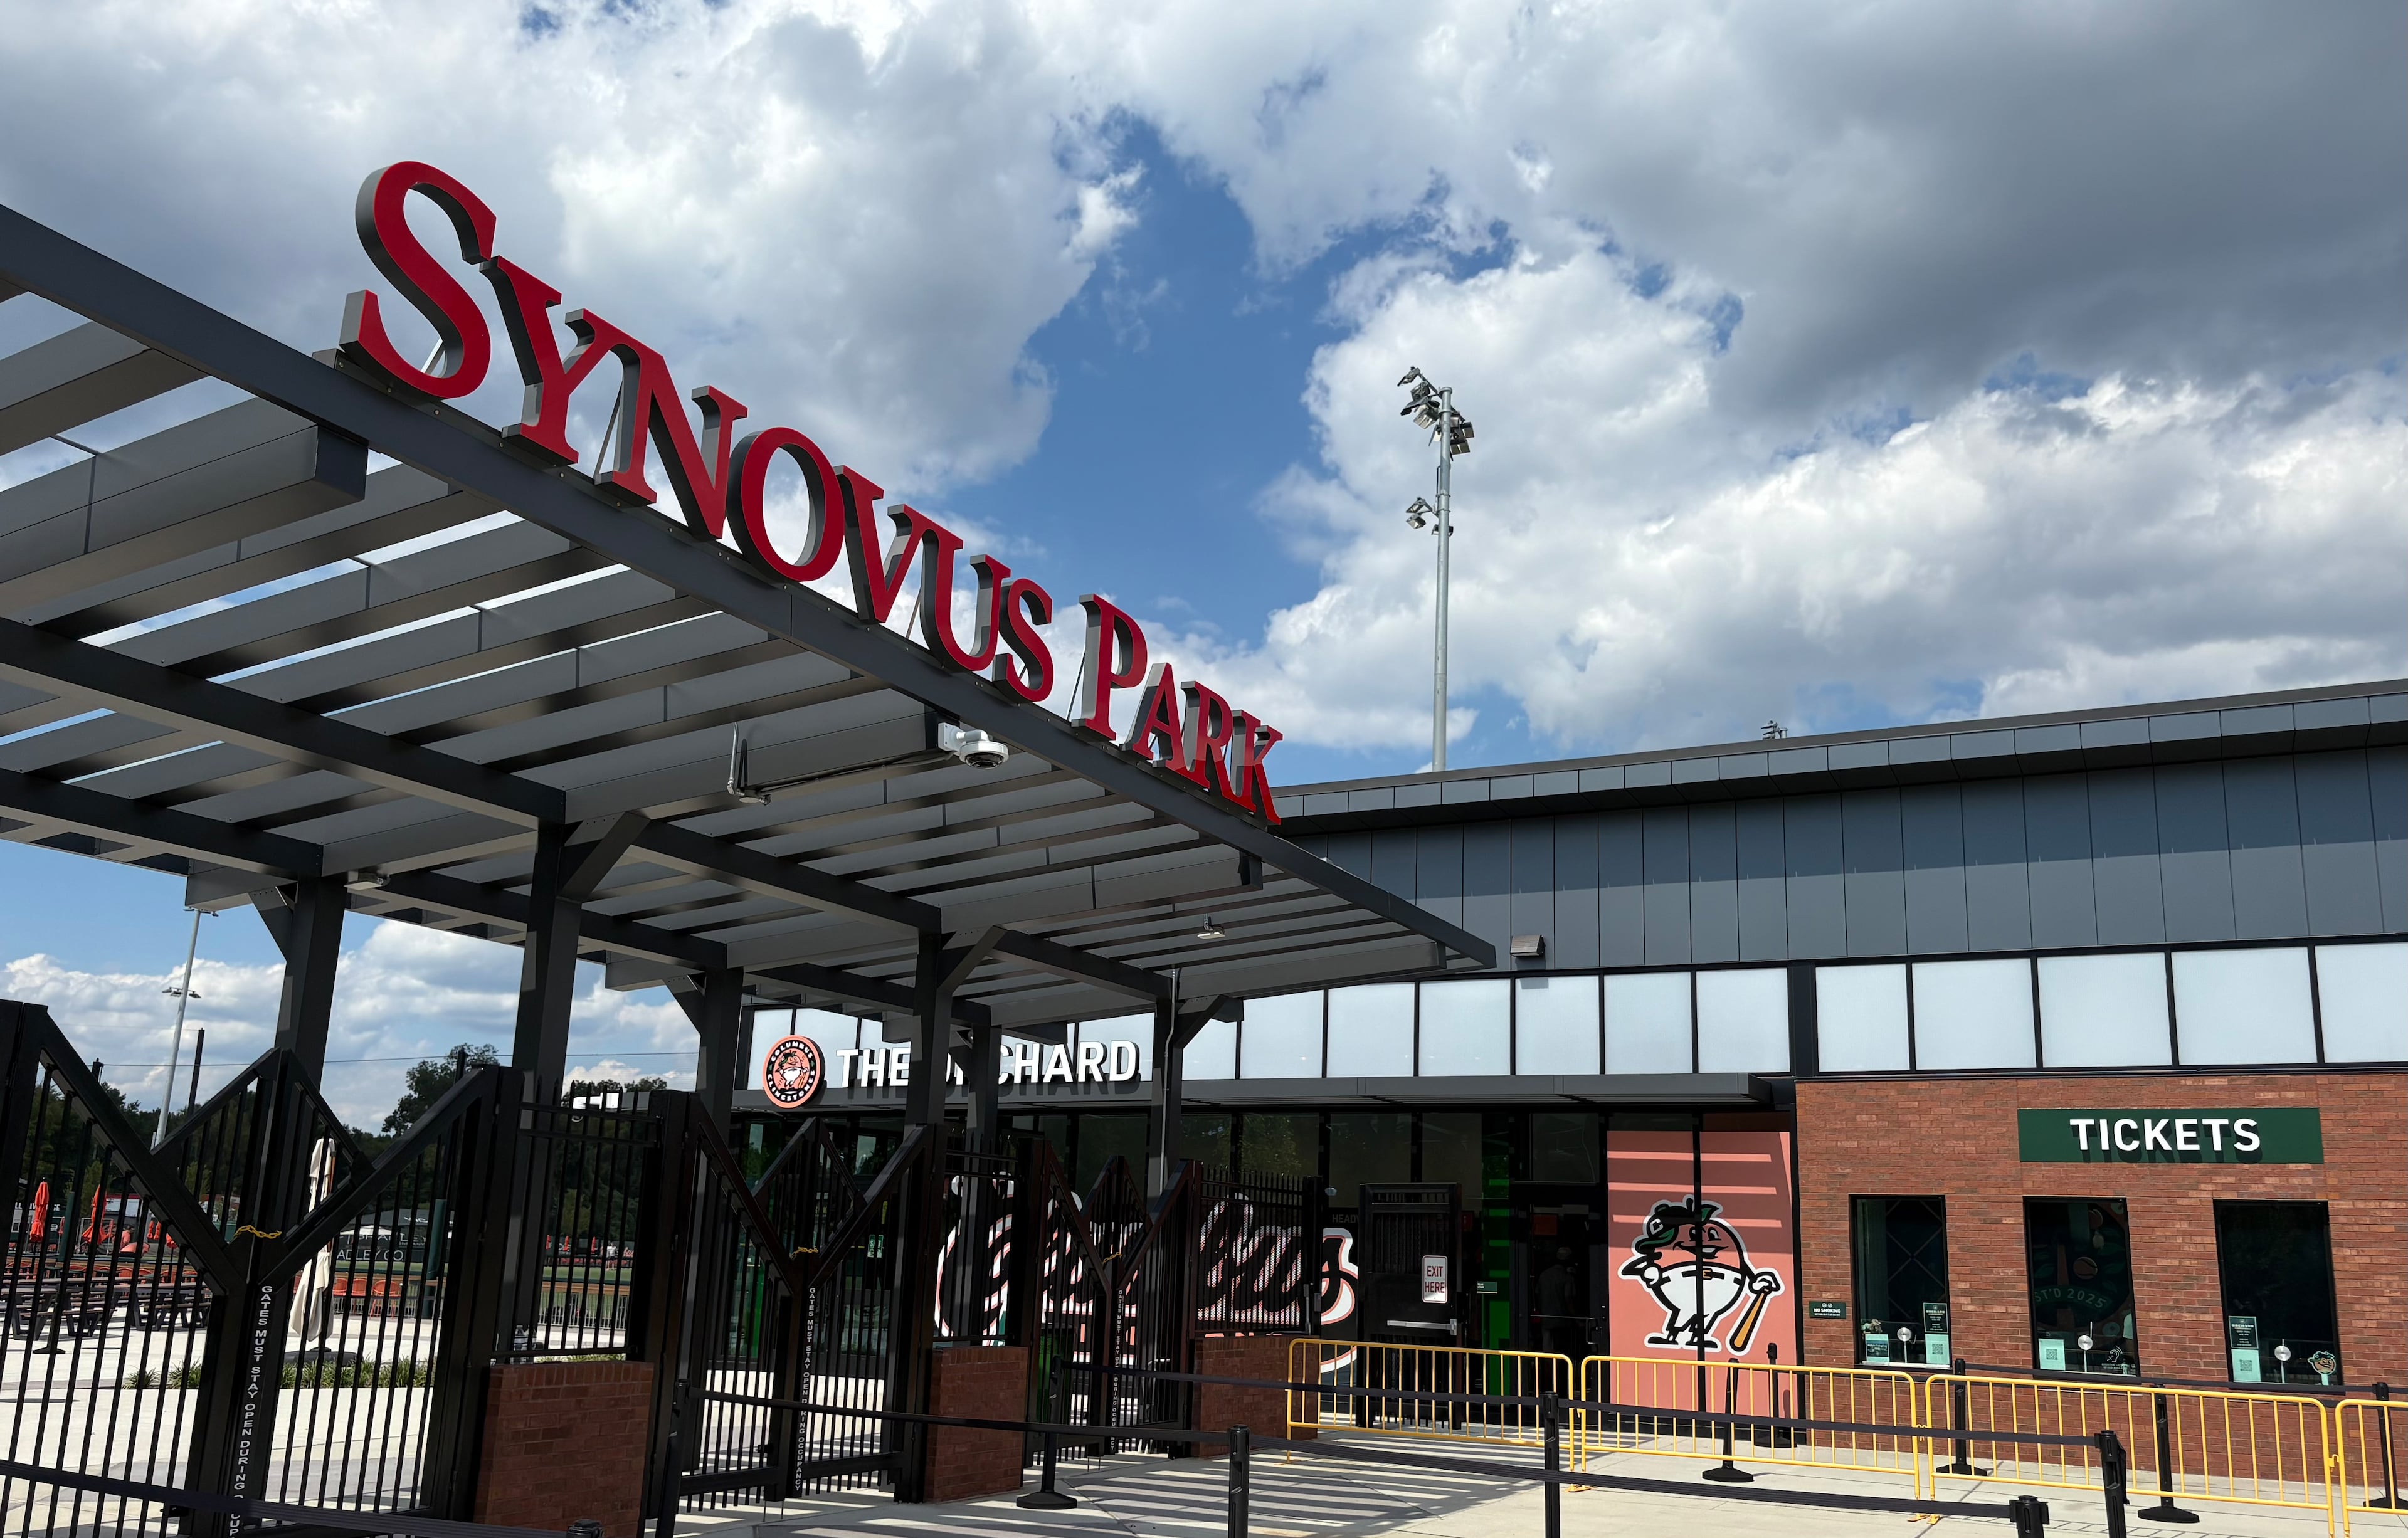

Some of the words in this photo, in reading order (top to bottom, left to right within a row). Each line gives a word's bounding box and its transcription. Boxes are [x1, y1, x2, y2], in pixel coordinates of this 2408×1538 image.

[339, 160, 1054, 703] SYNOVUS
[1072, 593, 1284, 826] PARK
[771, 1041, 813, 1061] COLUMBUS
[835, 1047, 910, 1088] THE
[946, 1040, 1137, 1086] CHARD
[767, 1070, 815, 1102] CLINGSTONES
[2069, 1118, 2261, 1152] TICKETS
[1425, 1282, 1445, 1293] HERE
[1427, 1265, 1443, 1277] EXIT
[258, 1285, 273, 1325] GATES
[808, 1287, 816, 1317] GATES
[2067, 1288, 2107, 1309] 2025
[253, 1330, 267, 1362] MUST
[247, 1366, 261, 1399] STAY
[801, 1372, 810, 1396] OPEN
[241, 1403, 256, 1436] OPEN
[798, 1398, 808, 1434] DRING
[233, 1440, 251, 1490] DURING
[795, 1436, 805, 1491] OCCUPANCY
